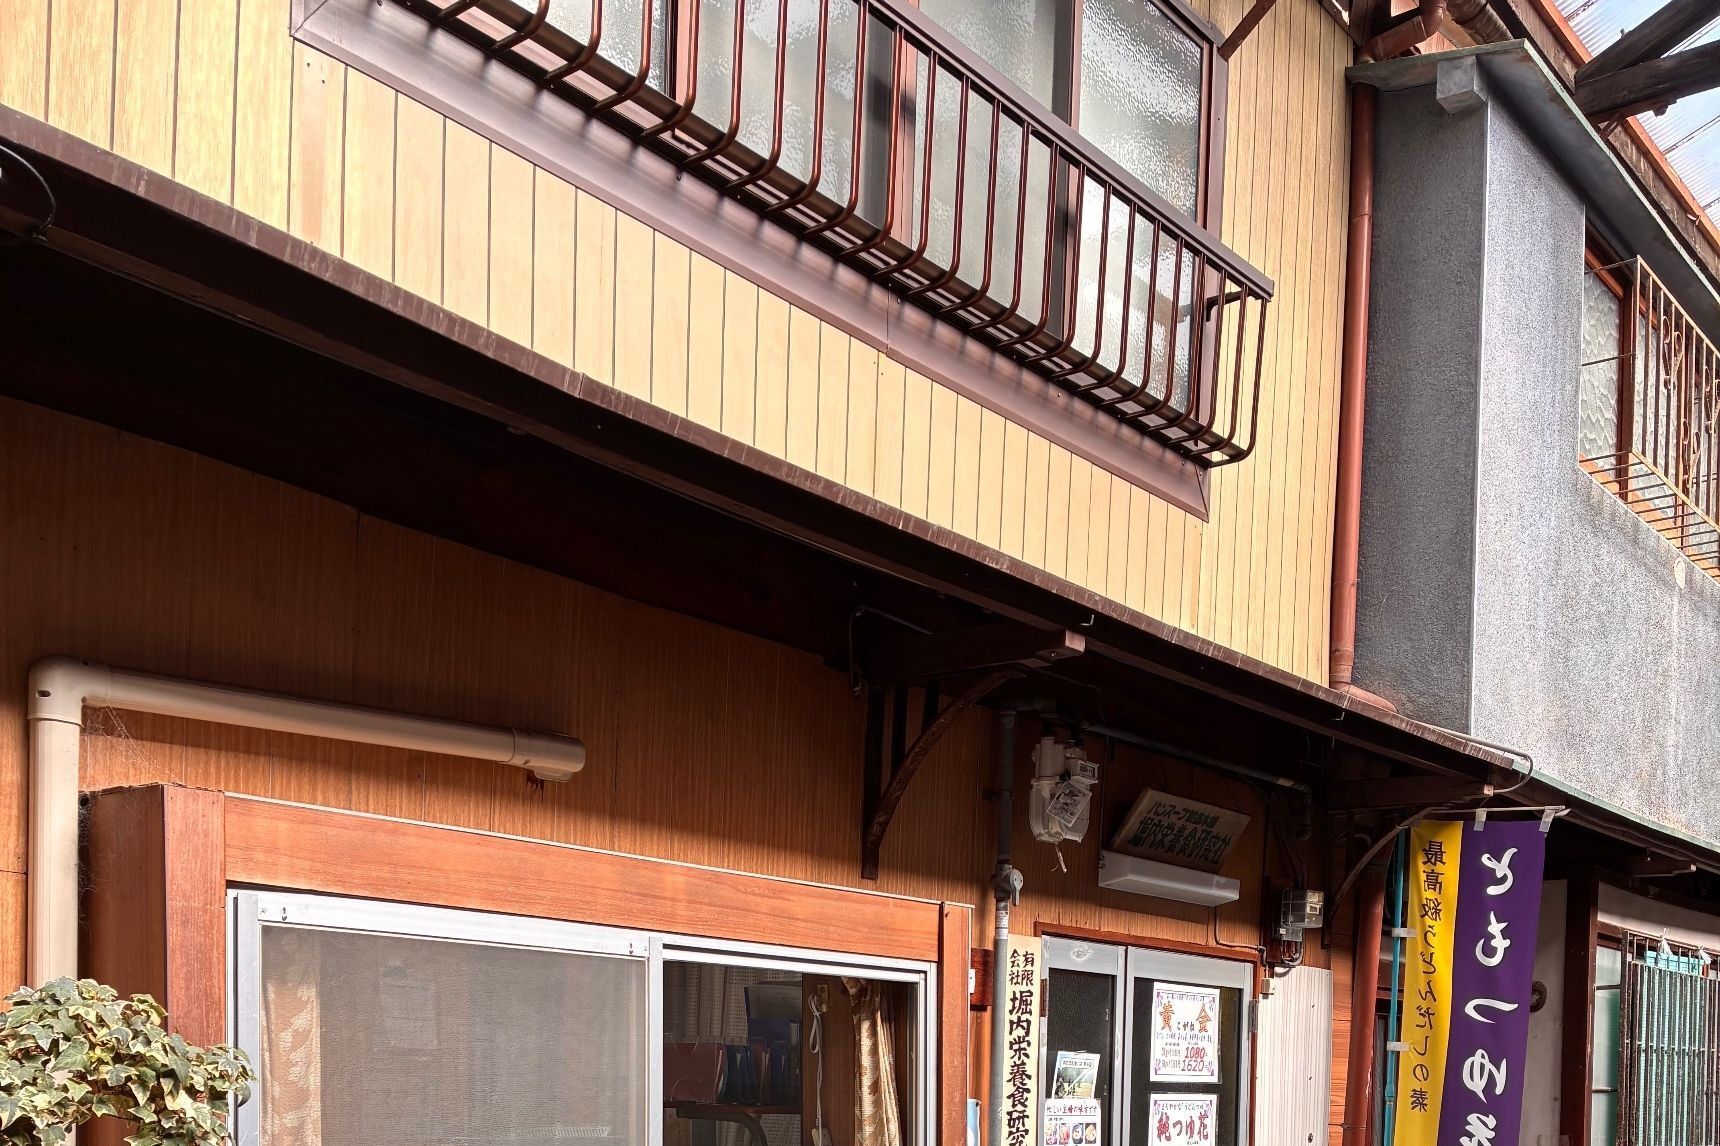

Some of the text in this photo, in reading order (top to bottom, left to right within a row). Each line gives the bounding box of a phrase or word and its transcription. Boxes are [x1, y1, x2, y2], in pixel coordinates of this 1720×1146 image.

[1184, 1046, 1205, 1059] 1080
[1181, 1060, 1204, 1071] 1620
[1157, 1110, 1209, 1142] 純つゆ花
